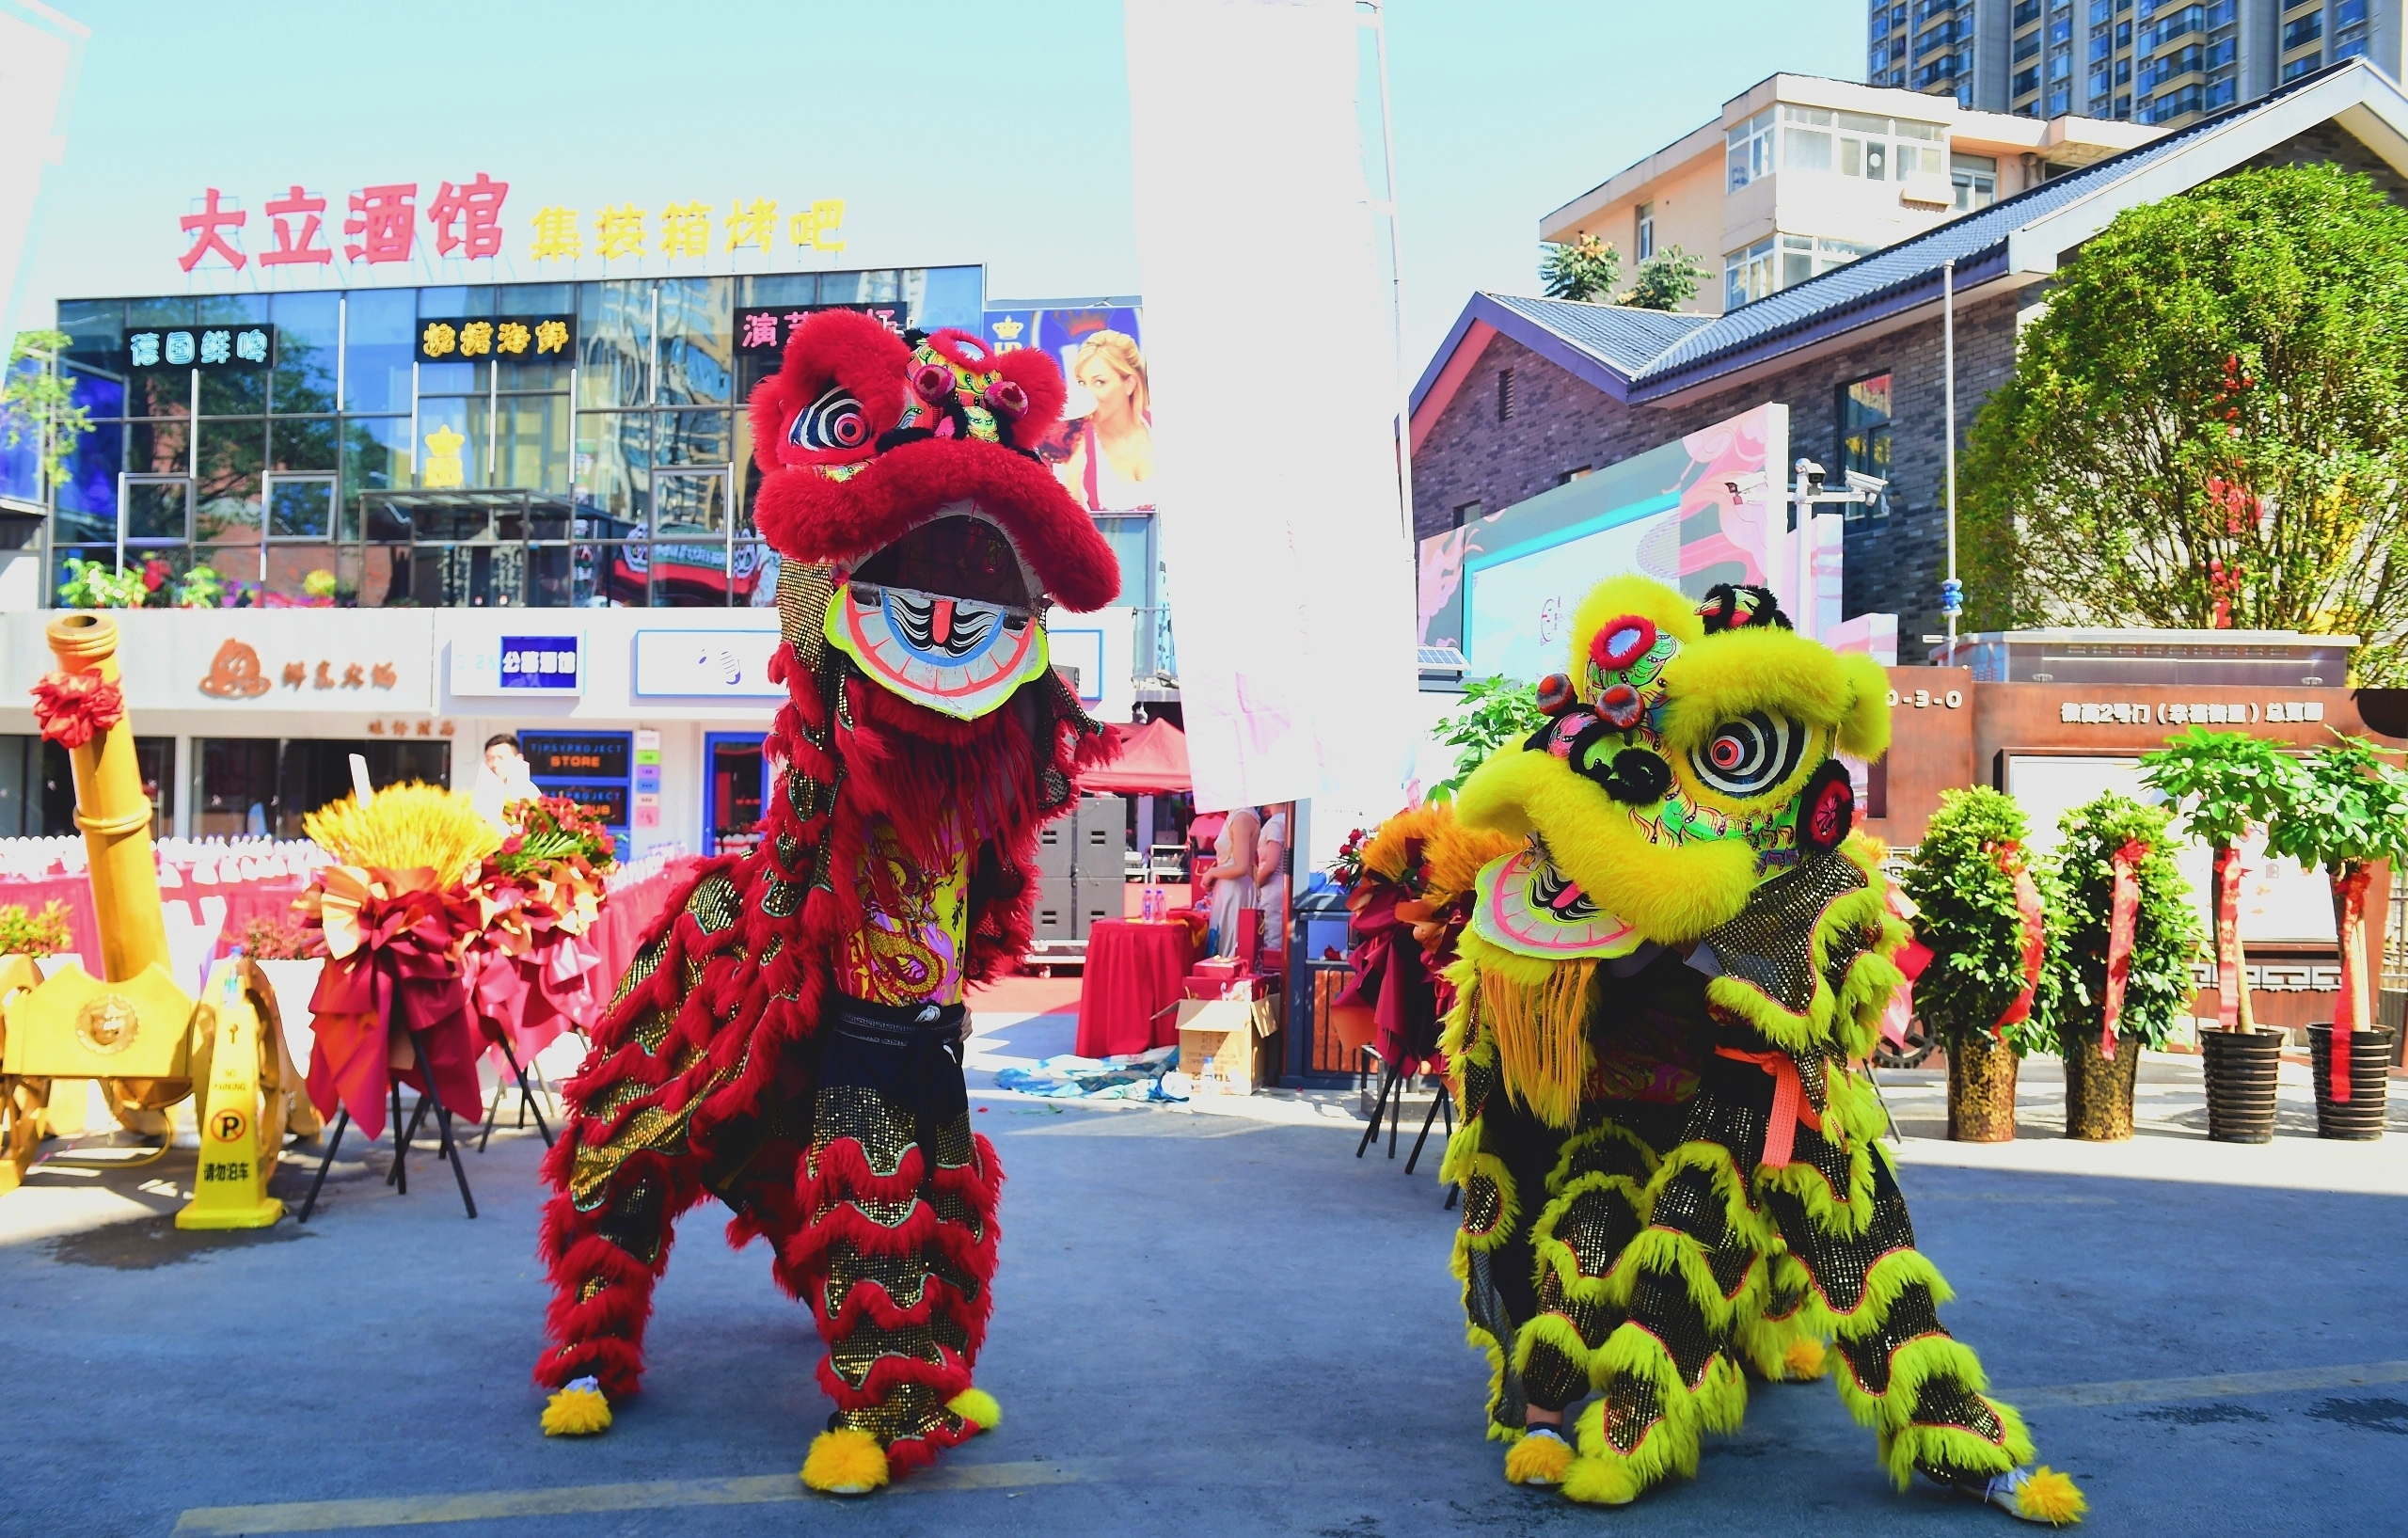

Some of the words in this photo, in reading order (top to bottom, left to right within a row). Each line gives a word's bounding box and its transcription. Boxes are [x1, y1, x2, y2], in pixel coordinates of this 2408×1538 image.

[178, 173, 509, 272] 大立酒馆
[530, 197, 847, 262] 集装箱烤吧
[131, 328, 268, 366] 德国鲜啤
[423, 320, 569, 357] 烧烤海鲜
[549, 755, 600, 768] STORE
[203, 1162, 249, 1182] 请勿泊车
